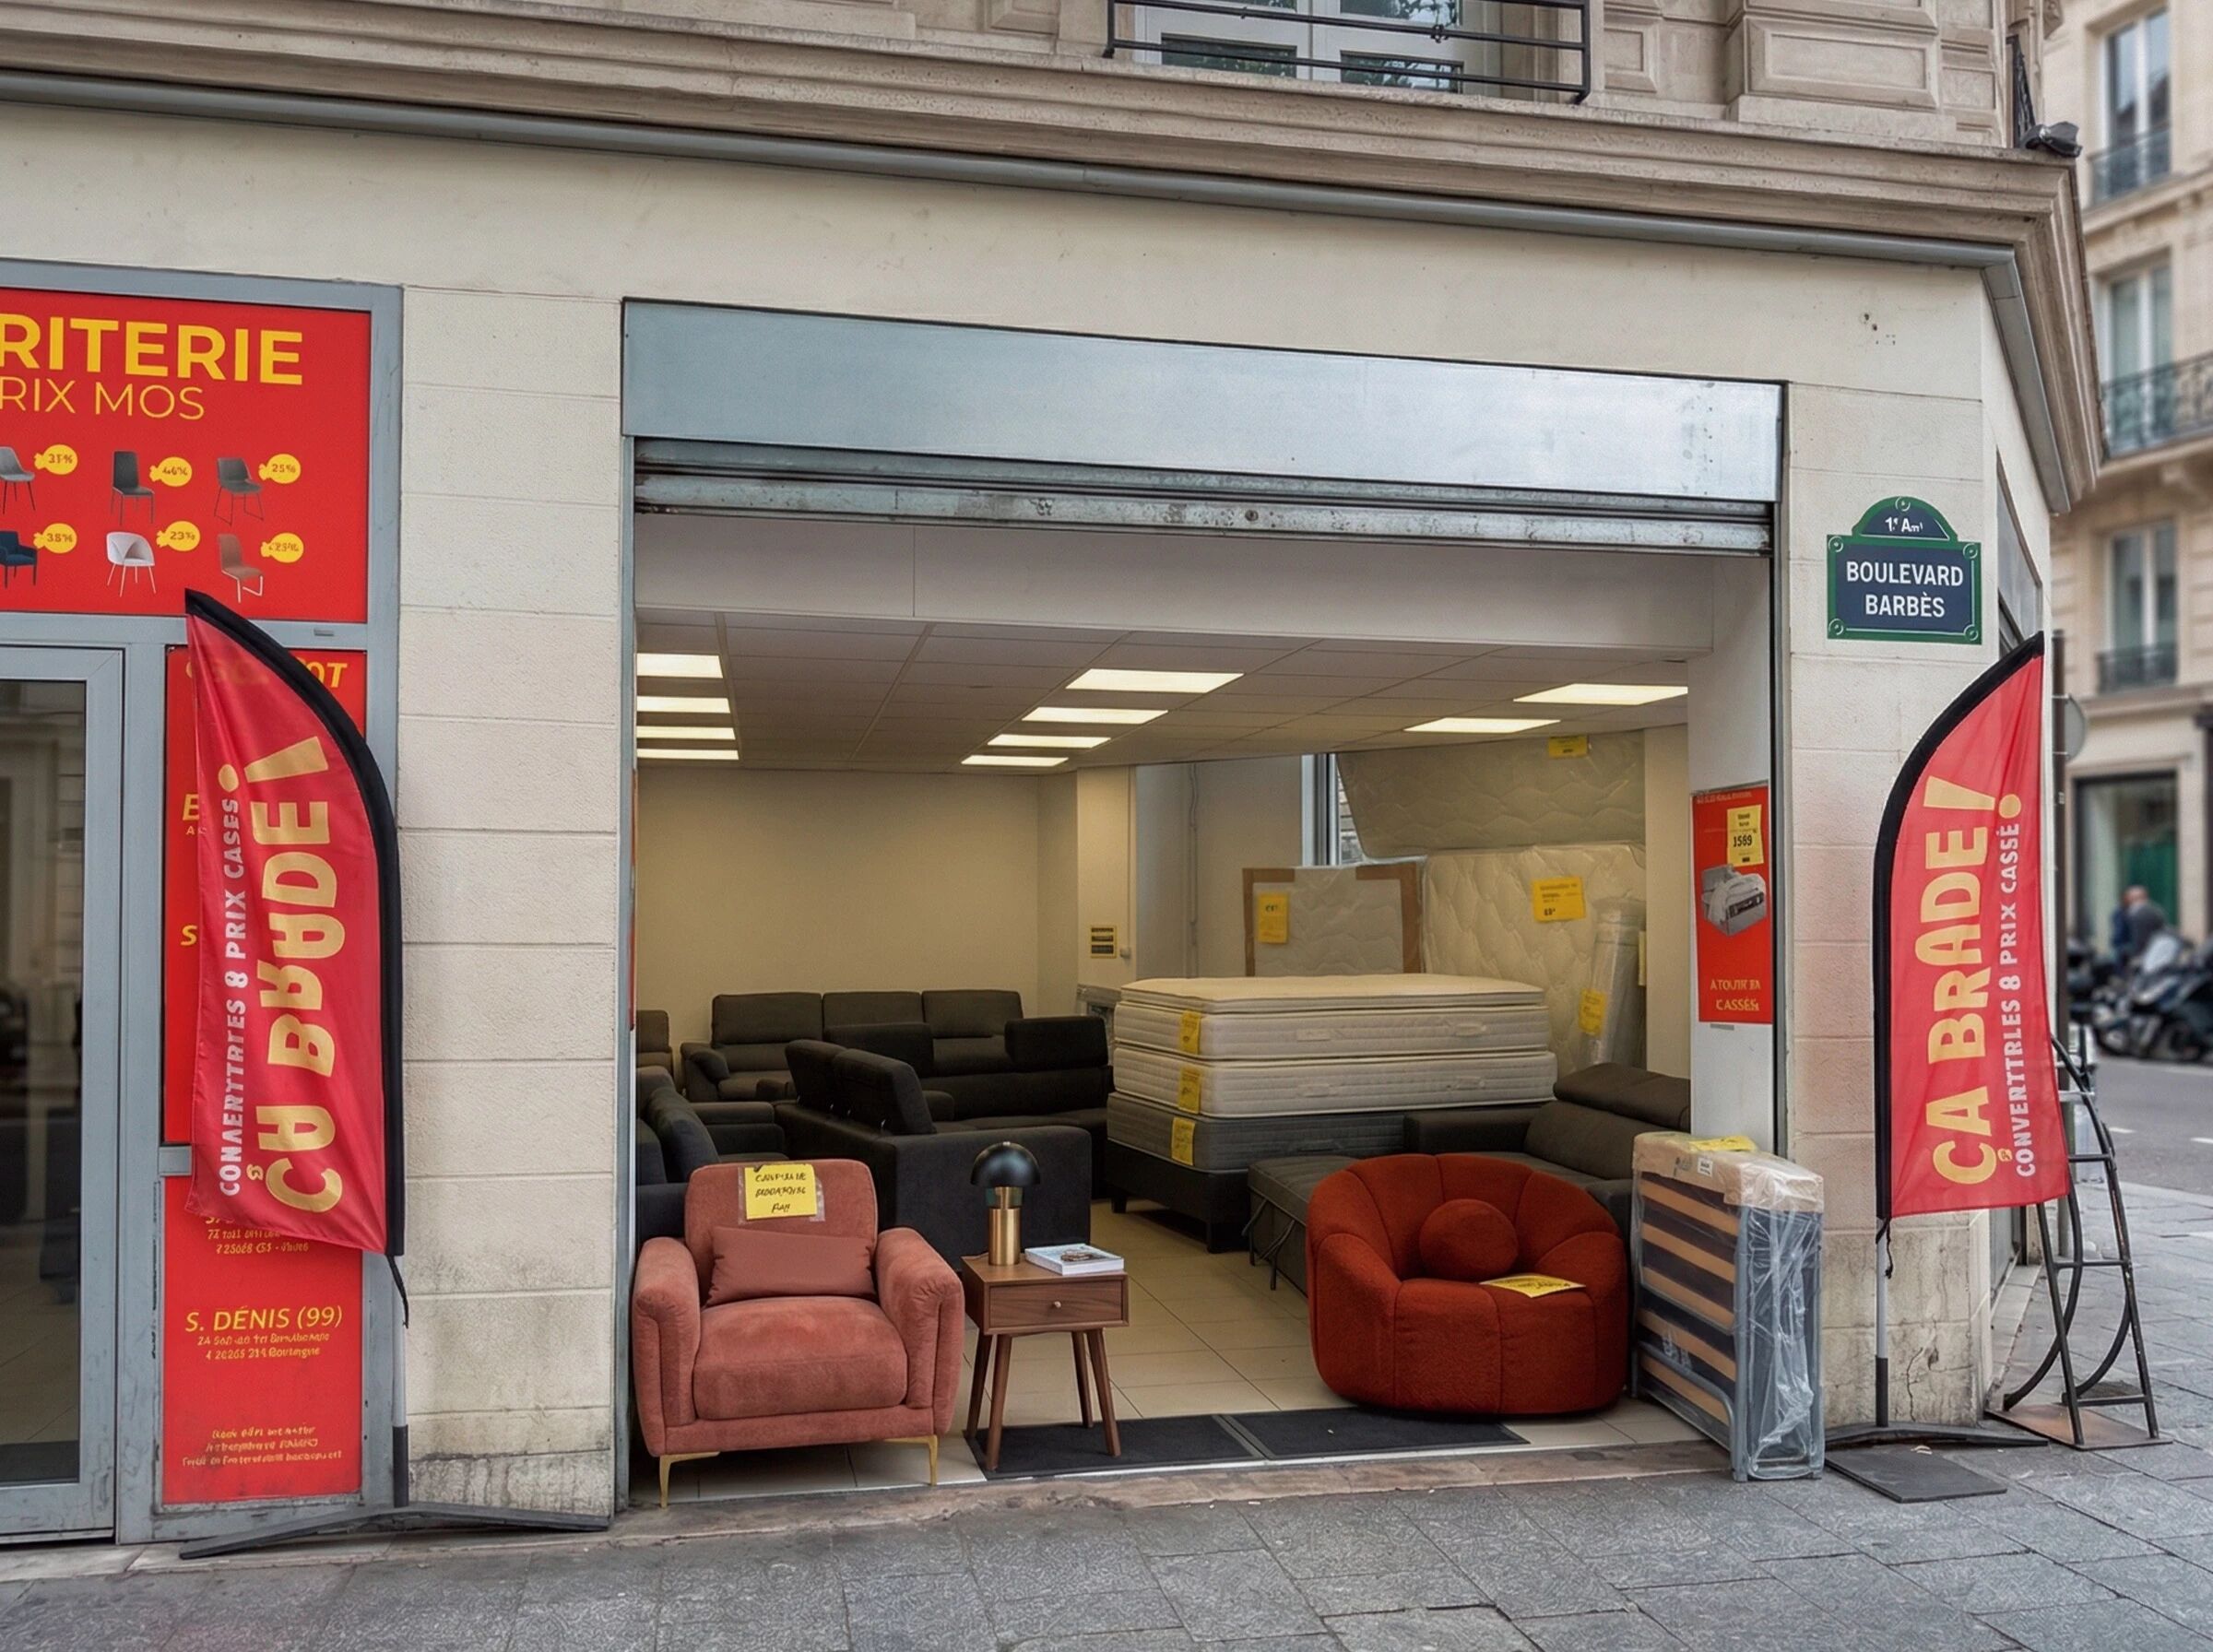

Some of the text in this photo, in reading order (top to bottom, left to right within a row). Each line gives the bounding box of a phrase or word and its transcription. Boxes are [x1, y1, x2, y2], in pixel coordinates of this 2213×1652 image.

[95, 381, 205, 420] MOS
[1846, 561, 1965, 586] BOULEVARD
[1865, 592, 1946, 618] BARBÈS
[1995, 823, 2020, 893] CASSÉ
[224, 890, 247, 960] PRIX
[1999, 902, 2018, 965] PRIX
[1915, 775, 2022, 1186] ÇA BRADE!
[185, 1304, 343, 1332] S. DÉNIS (99)
